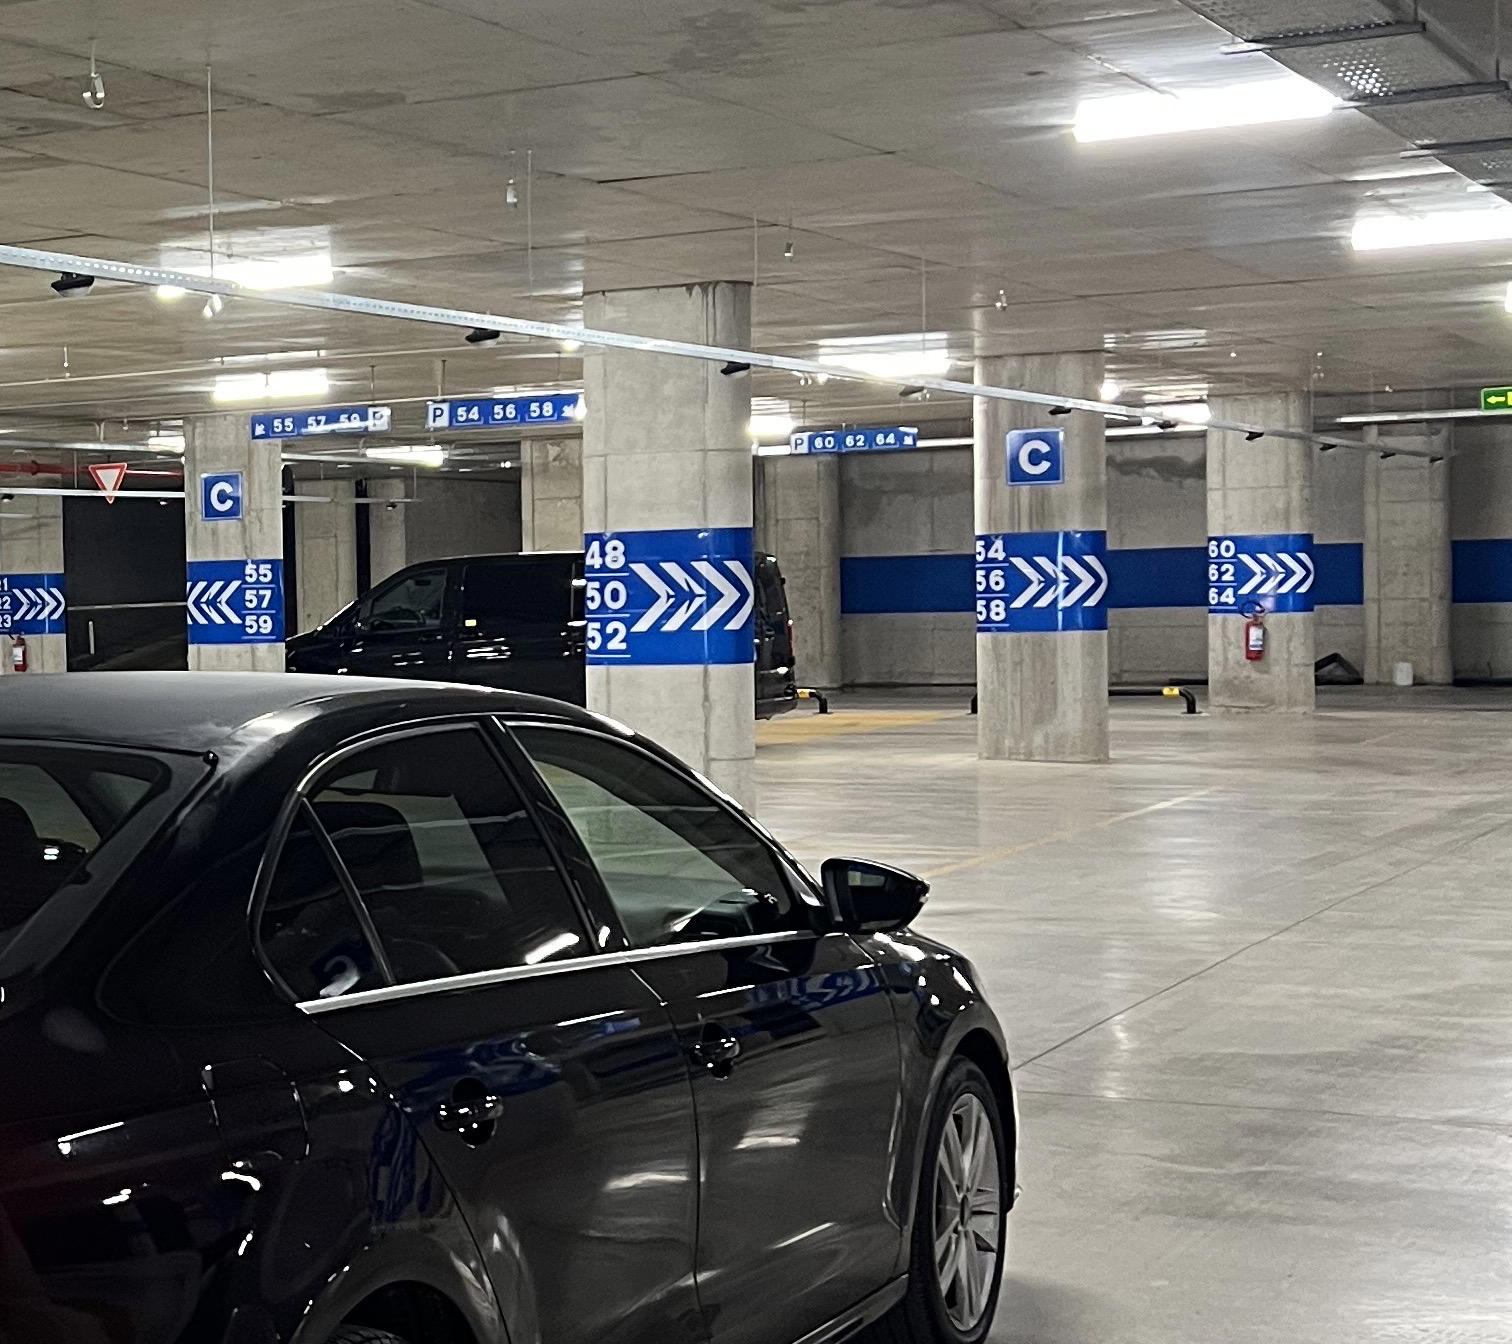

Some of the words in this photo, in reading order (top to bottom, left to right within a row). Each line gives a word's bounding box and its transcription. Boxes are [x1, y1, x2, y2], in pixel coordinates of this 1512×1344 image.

[433, 407, 444, 423] P
[456, 406, 479, 422] 54
[493, 403, 516, 420] 56
[530, 401, 553, 417] 58
[273, 417, 293, 432] 55
[307, 415, 327, 429] 57
[794, 437, 805, 450] P
[814, 436, 835, 449] 60
[845, 434, 865, 447] 62
[875, 432, 896, 445] 64
[1018, 439, 1052, 475] C
[210, 481, 234, 512] C
[585, 539, 626, 570] 48
[975, 539, 1006, 562] 54
[1208, 540, 1235, 558] 60
[244, 563, 273, 583] 55
[976, 569, 1006, 592] 56
[1208, 563, 1235, 581] 62
[244, 589, 272, 608] 57
[586, 580, 627, 610] 50
[1208, 587, 1236, 605] 64
[976, 599, 1006, 622] 58
[245, 615, 273, 634] 59
[587, 620, 627, 650] 52
